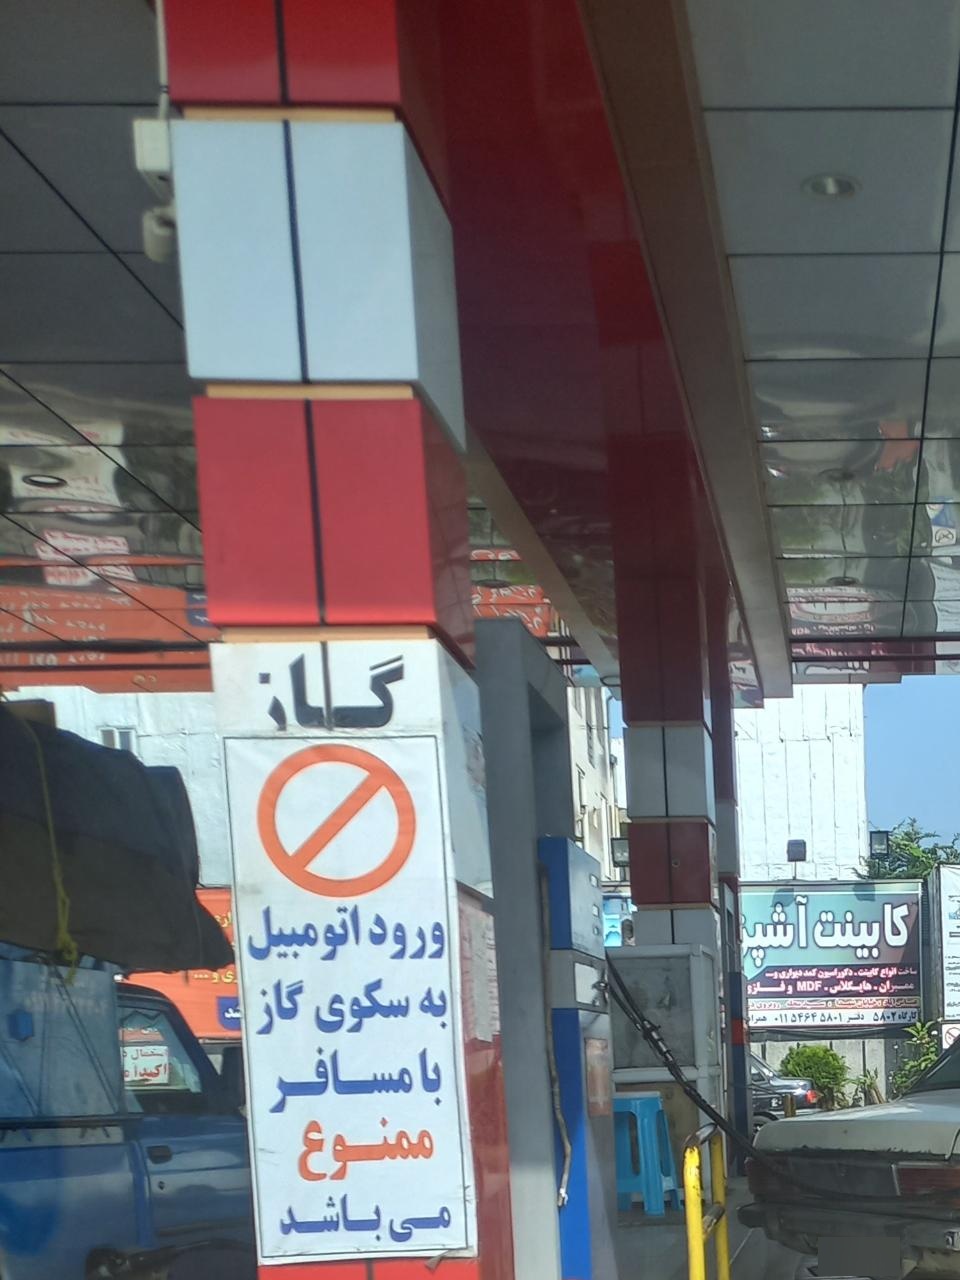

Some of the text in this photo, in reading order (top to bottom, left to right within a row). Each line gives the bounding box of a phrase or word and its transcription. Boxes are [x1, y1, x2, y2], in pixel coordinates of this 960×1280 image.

[258, 654, 404, 732] گاز
[247, 904, 445, 961] ورود اتومبیل
[813, 902, 909, 960] کابینت
[256, 978, 448, 1035] به سکوی گاز
[797, 980, 822, 991] MDF
[750, 1013, 768, 1024] همرا
[898, 1010, 917, 1022] کارگاه
[269, 1046, 442, 1113] با مسافر
[298, 1117, 434, 1182] ممنوع
[280, 1194, 451, 1242] می باشد
